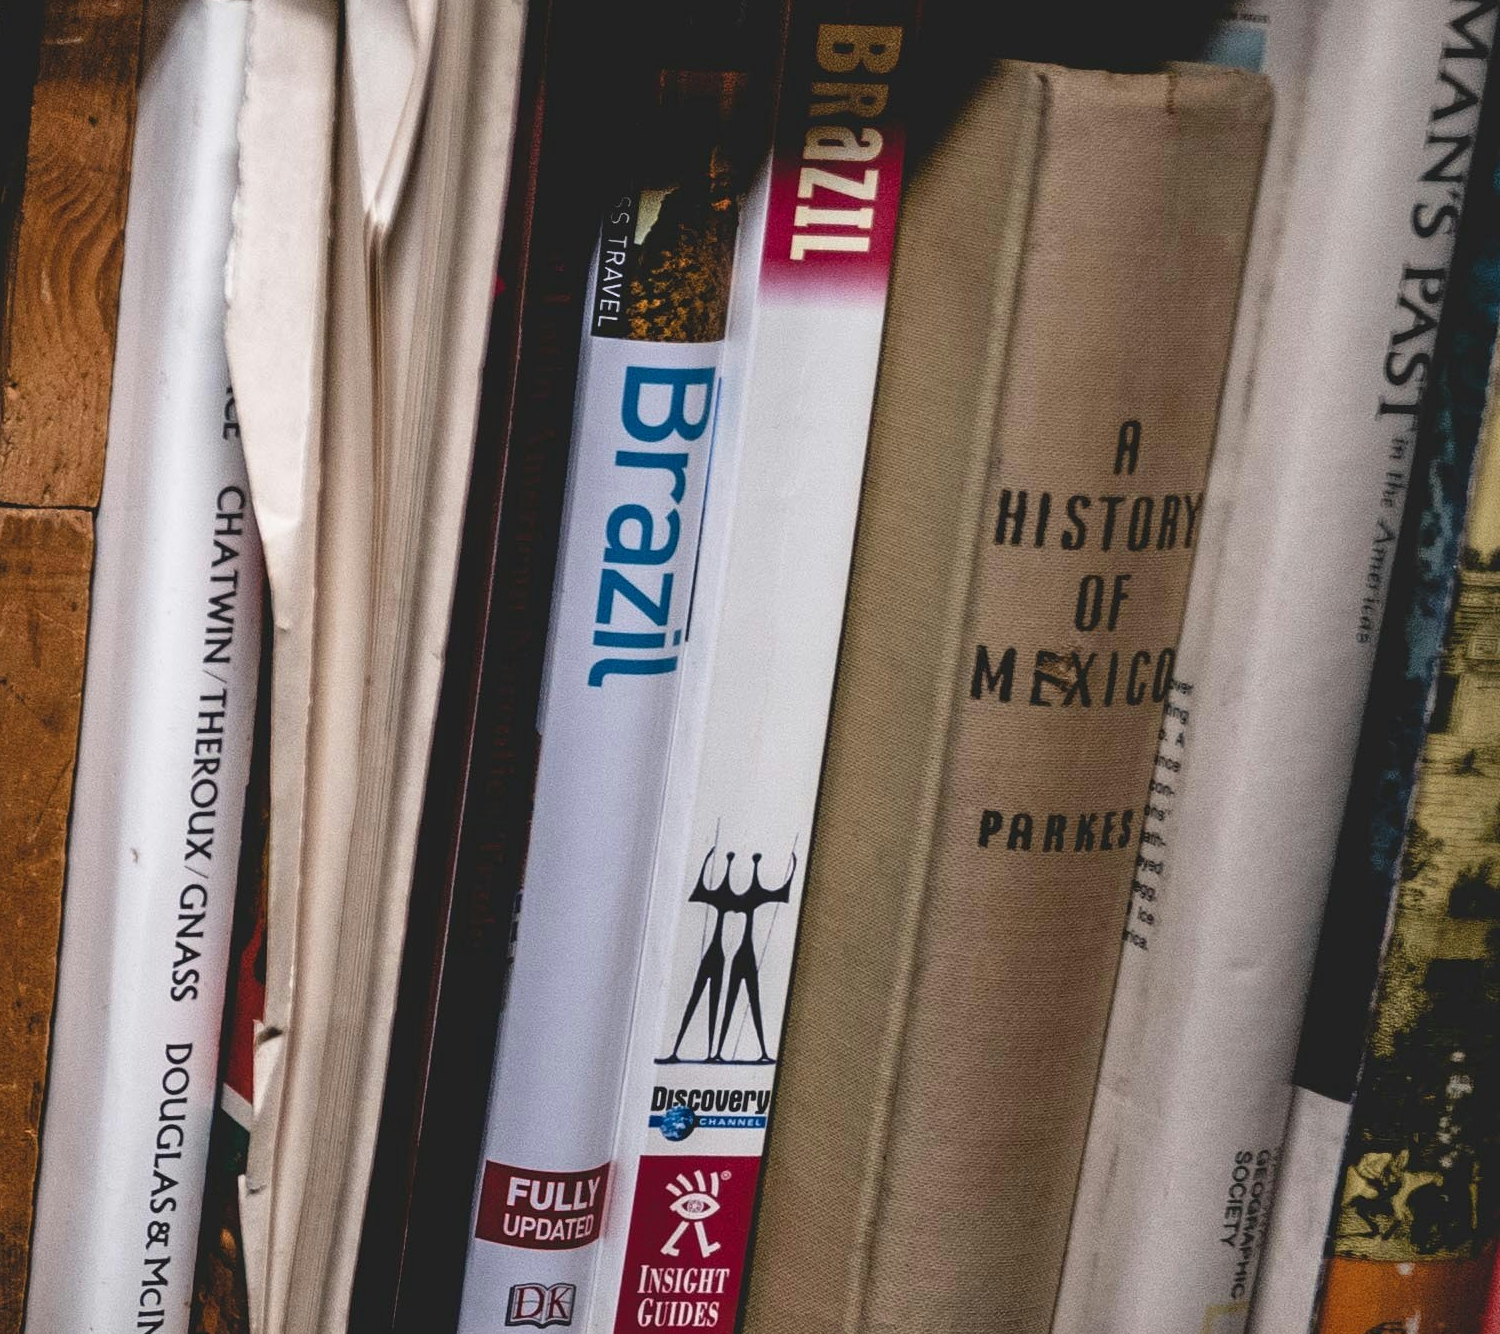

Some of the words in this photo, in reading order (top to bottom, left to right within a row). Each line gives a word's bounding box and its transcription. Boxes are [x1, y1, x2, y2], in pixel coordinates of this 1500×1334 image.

[587, 365, 716, 689] Brazil
[995, 491, 1202, 551] HISTORY
[1075, 575, 1131, 631] OF
[650, 1087, 770, 1115] Discovery
[506, 1178, 600, 1211] FULLY
[503, 1216, 594, 1242] UPDATED
[638, 1267, 728, 1294] INSIGHT
[636, 1300, 719, 1328] GUIDES
